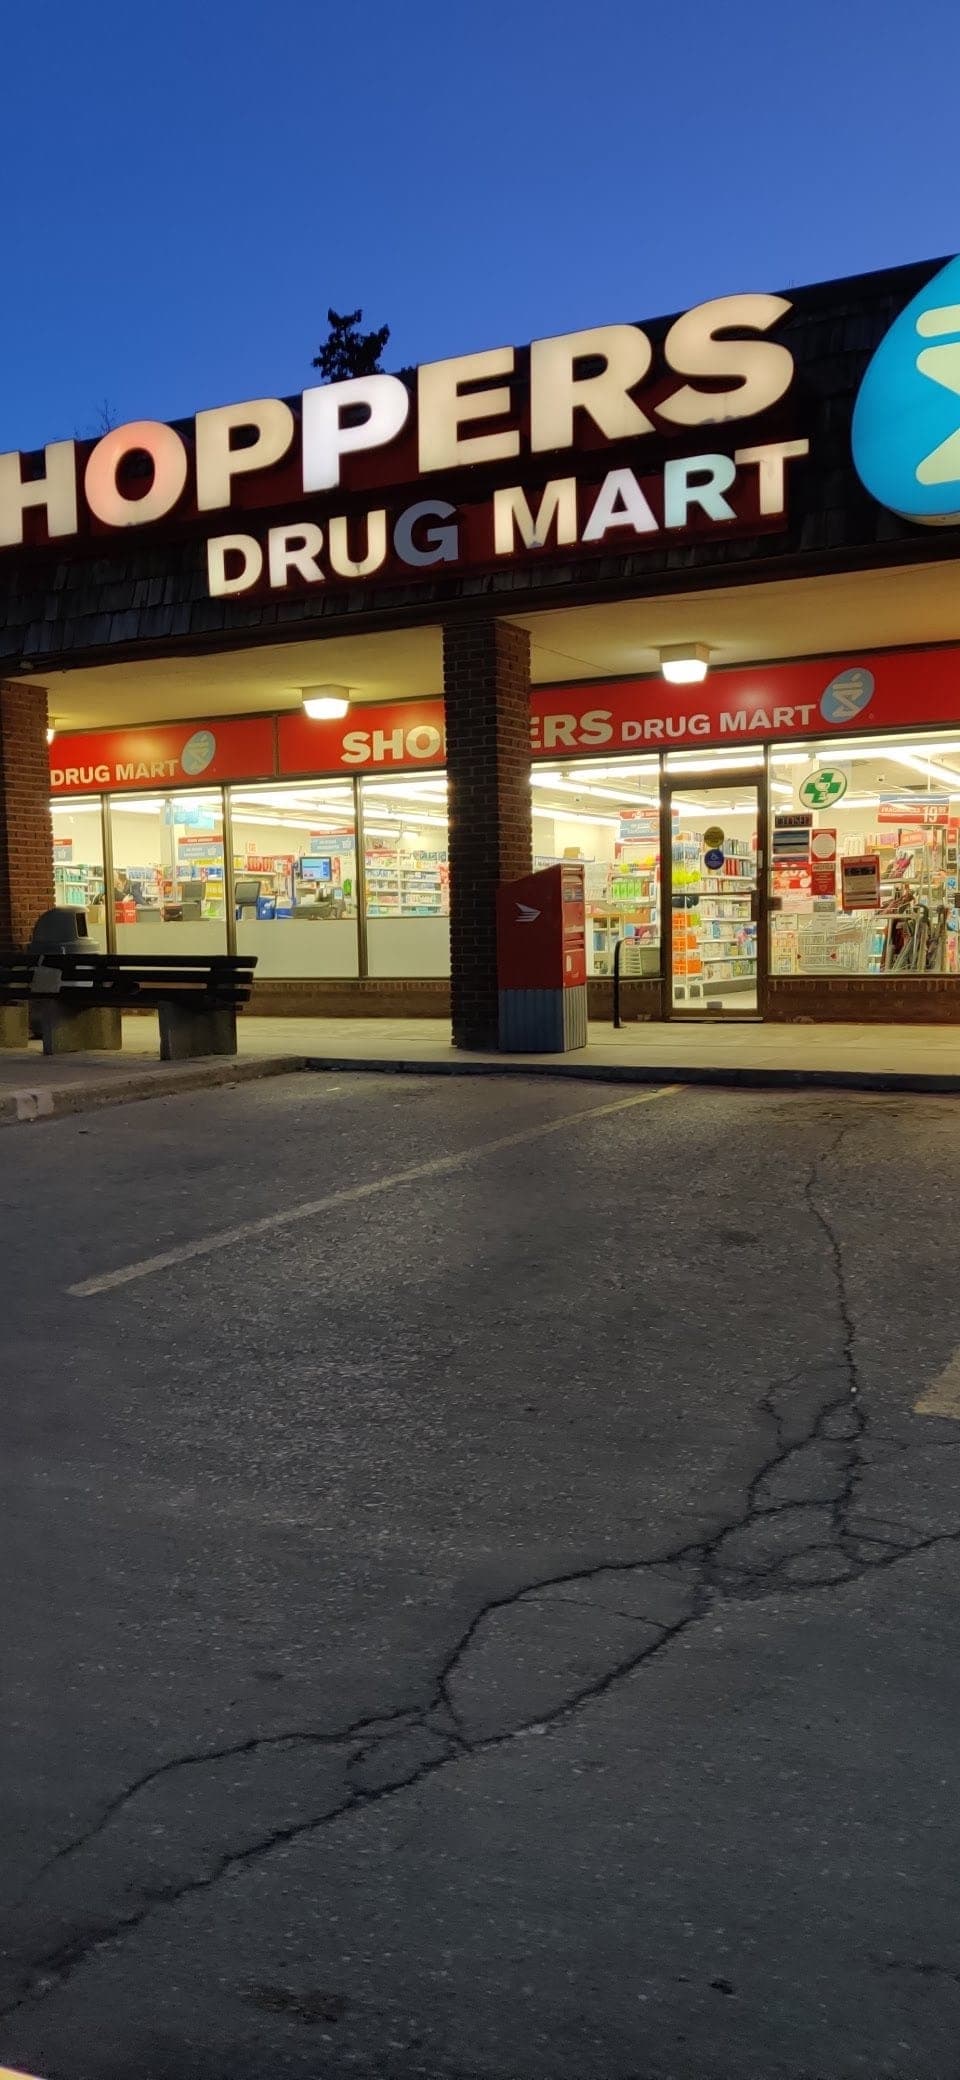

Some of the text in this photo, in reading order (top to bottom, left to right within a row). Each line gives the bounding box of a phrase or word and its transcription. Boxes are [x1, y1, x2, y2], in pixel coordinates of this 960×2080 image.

[0, 292, 794, 548] HOPPERS
[207, 439, 809, 597] DRUG MART
[622, 714, 711, 742] DRUG
[719, 704, 817, 733] MART
[50, 759, 179, 786] DRUG MART
